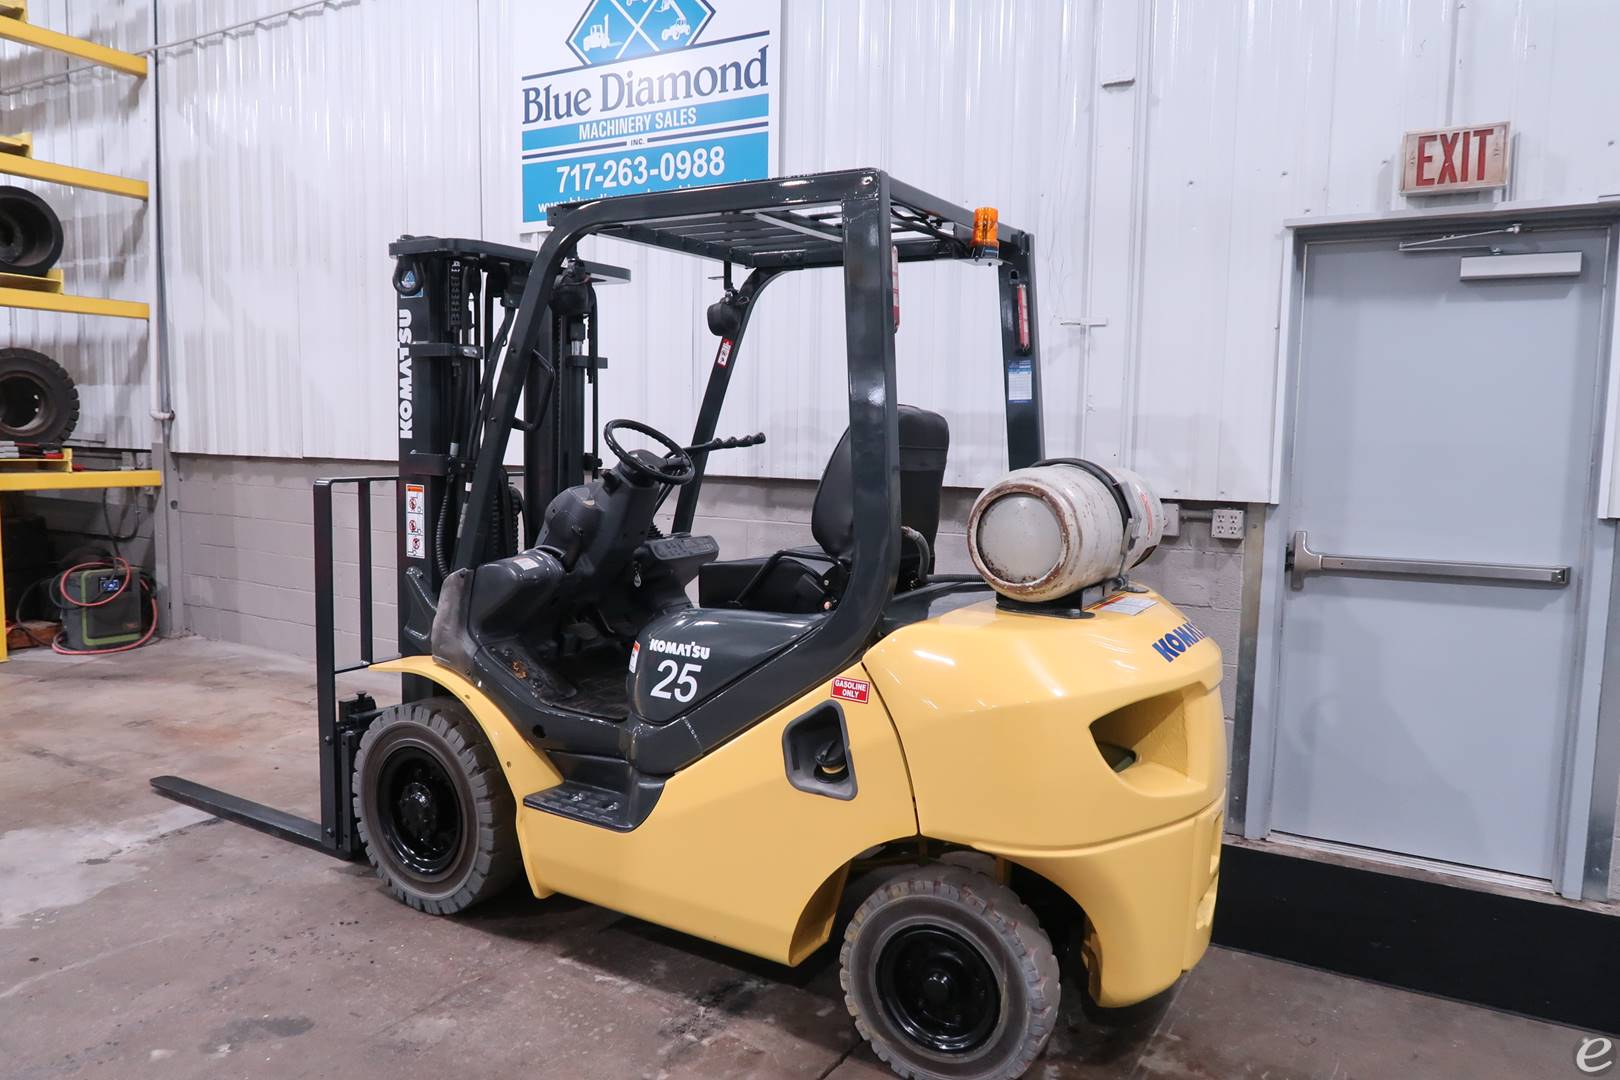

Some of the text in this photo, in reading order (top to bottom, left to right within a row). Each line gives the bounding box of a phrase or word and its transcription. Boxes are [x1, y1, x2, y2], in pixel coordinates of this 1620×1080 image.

[522, 45, 769, 125] Blue Diamond
[579, 107, 697, 141] MACHINERY SALES
[630, 136, 646, 147] INC.
[557, 146, 725, 193] 717-263-0988
[1416, 129, 1494, 186] EXIT
[397, 309, 413, 439] KOMATSU
[649, 639, 710, 659] KOMATSU
[650, 659, 702, 703] 25
[834, 679, 867, 692] GASOLINE
[842, 689, 859, 699] ONLY
